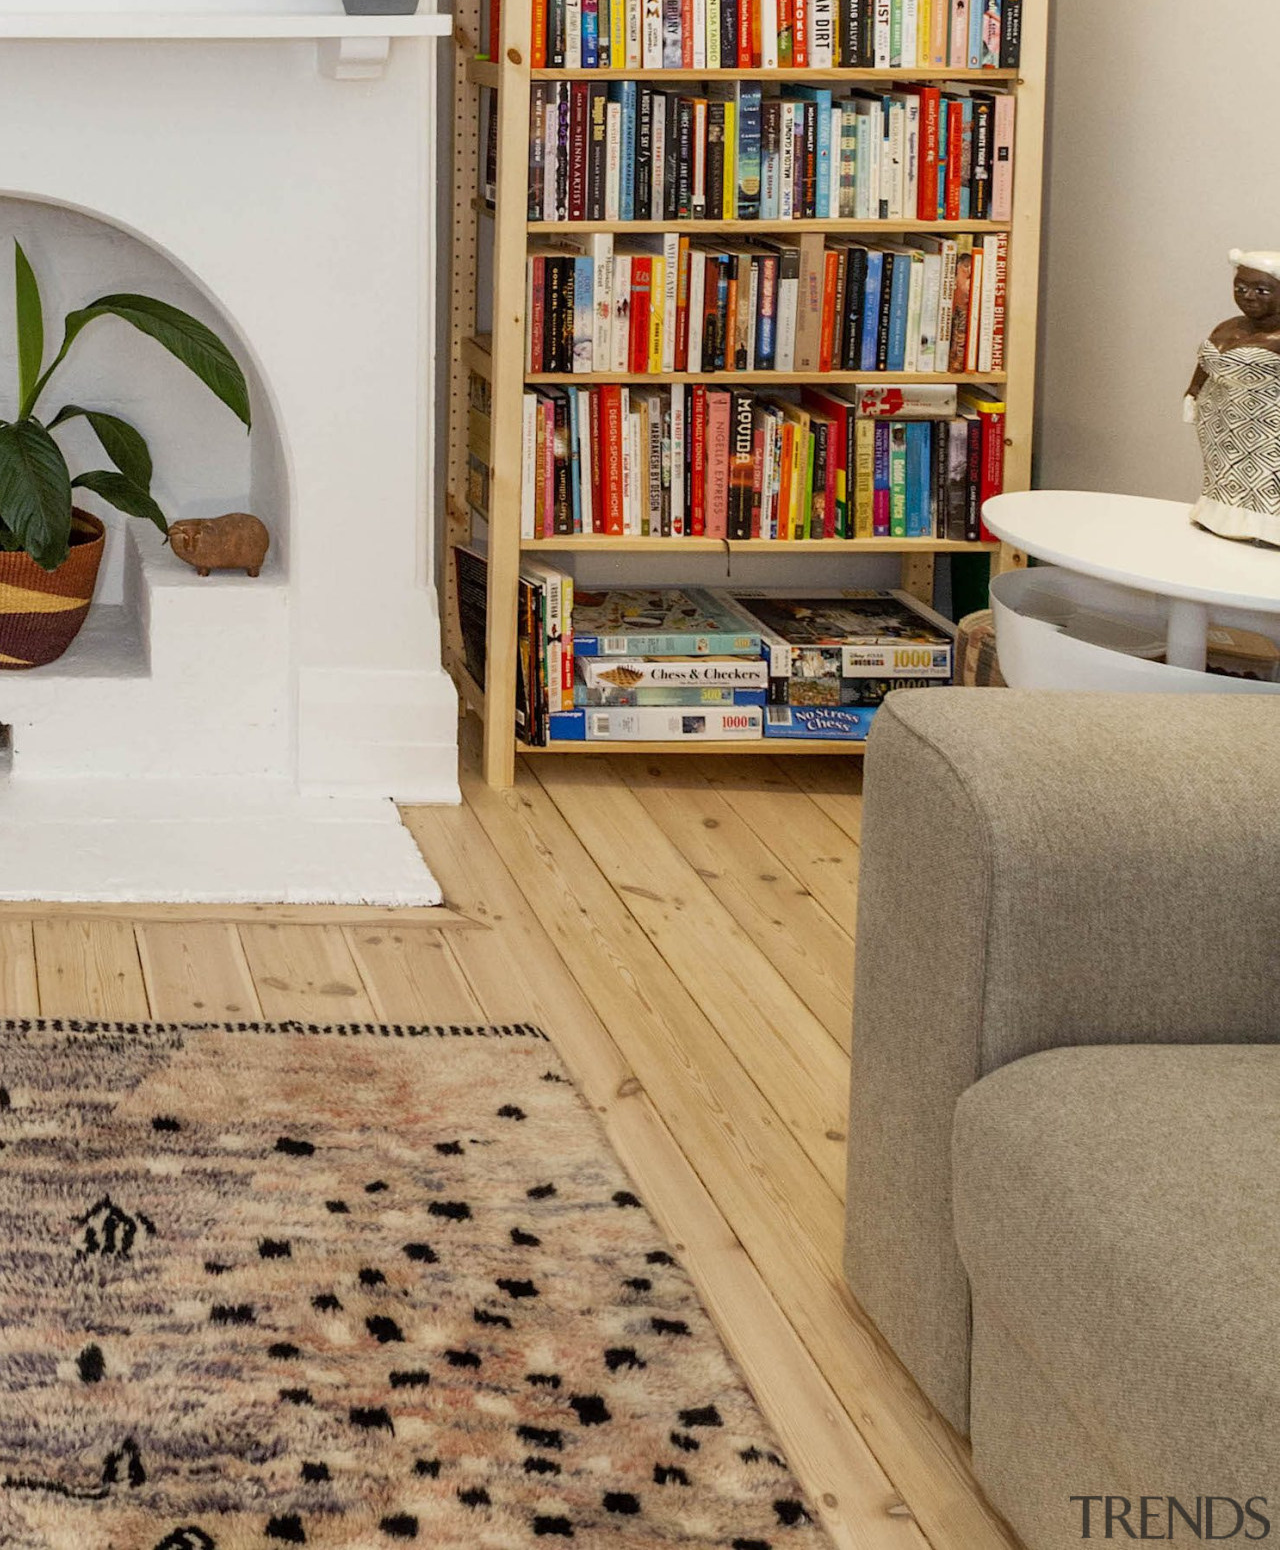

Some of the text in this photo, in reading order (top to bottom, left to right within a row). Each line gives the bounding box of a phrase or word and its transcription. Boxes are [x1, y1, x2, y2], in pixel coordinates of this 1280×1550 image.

[667, 0, 679, 34] BRUNY
[710, 8, 718, 25] LISA
[710, 28, 718, 62] TADDEO
[815, 19, 830, 49] DIRT
[849, 21, 858, 52] SILVEY
[592, 96, 606, 141] Shuggie Bain
[642, 95, 650, 114] HOUSE
[925, 99, 936, 124] marley
[641, 124, 650, 136] THE
[641, 137, 649, 148] SKY
[978, 114, 987, 165] THE WHITE TIGER
[784, 118, 793, 179] MALCOLM GLADWELL
[572, 134, 583, 205] HENNA ARTIST
[783, 191, 791, 216] BLINK
[666, 243, 675, 300] WILD GAME
[992, 233, 1008, 372] NEW RULES BILL MAHER
[695, 398, 704, 471] THE FAMILY DINNER
[735, 398, 752, 465] MOVIDA
[650, 422, 659, 512] MARRAKESH BY DESIGN
[714, 421, 725, 515] NIGELLA EXPRESS
[875, 428, 883, 480] NORTH STAR
[650, 668, 760, 680] Chess Checkers
[893, 650, 932, 668] 1000
[722, 716, 748, 728] 1000
[794, 708, 860, 724] No Stress
[806, 718, 851, 733] Chess
